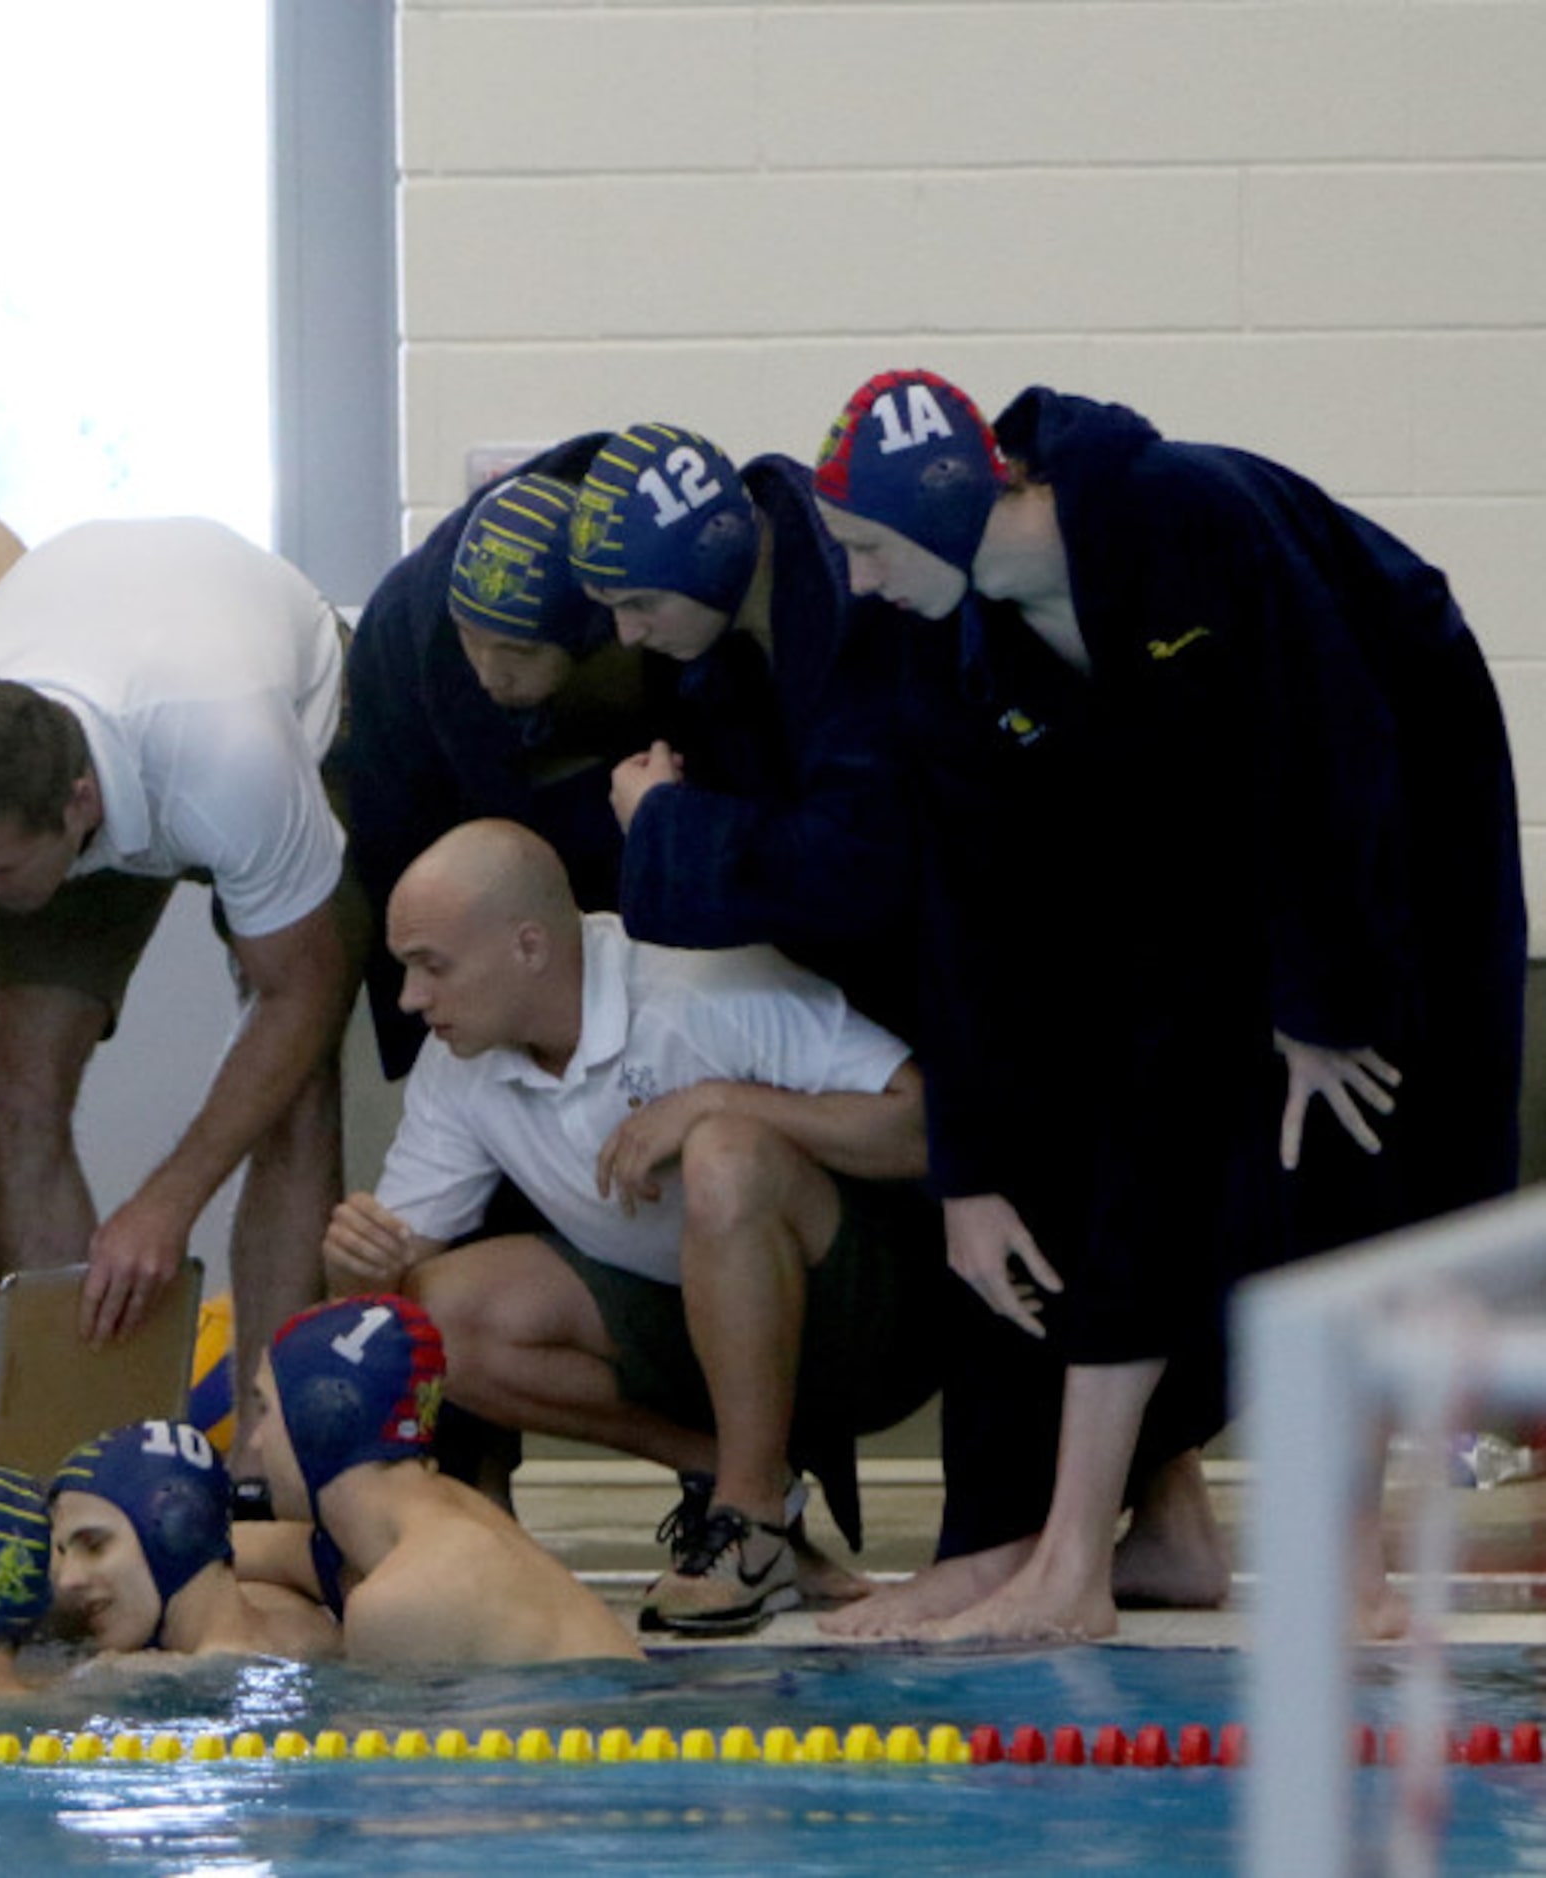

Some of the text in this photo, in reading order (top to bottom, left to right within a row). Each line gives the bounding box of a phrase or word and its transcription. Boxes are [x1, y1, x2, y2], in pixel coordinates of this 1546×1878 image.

[871, 384, 953, 454] 1A
[636, 446, 722, 528] 12
[331, 1305, 393, 1364] 1
[140, 1420, 213, 1469] 10
